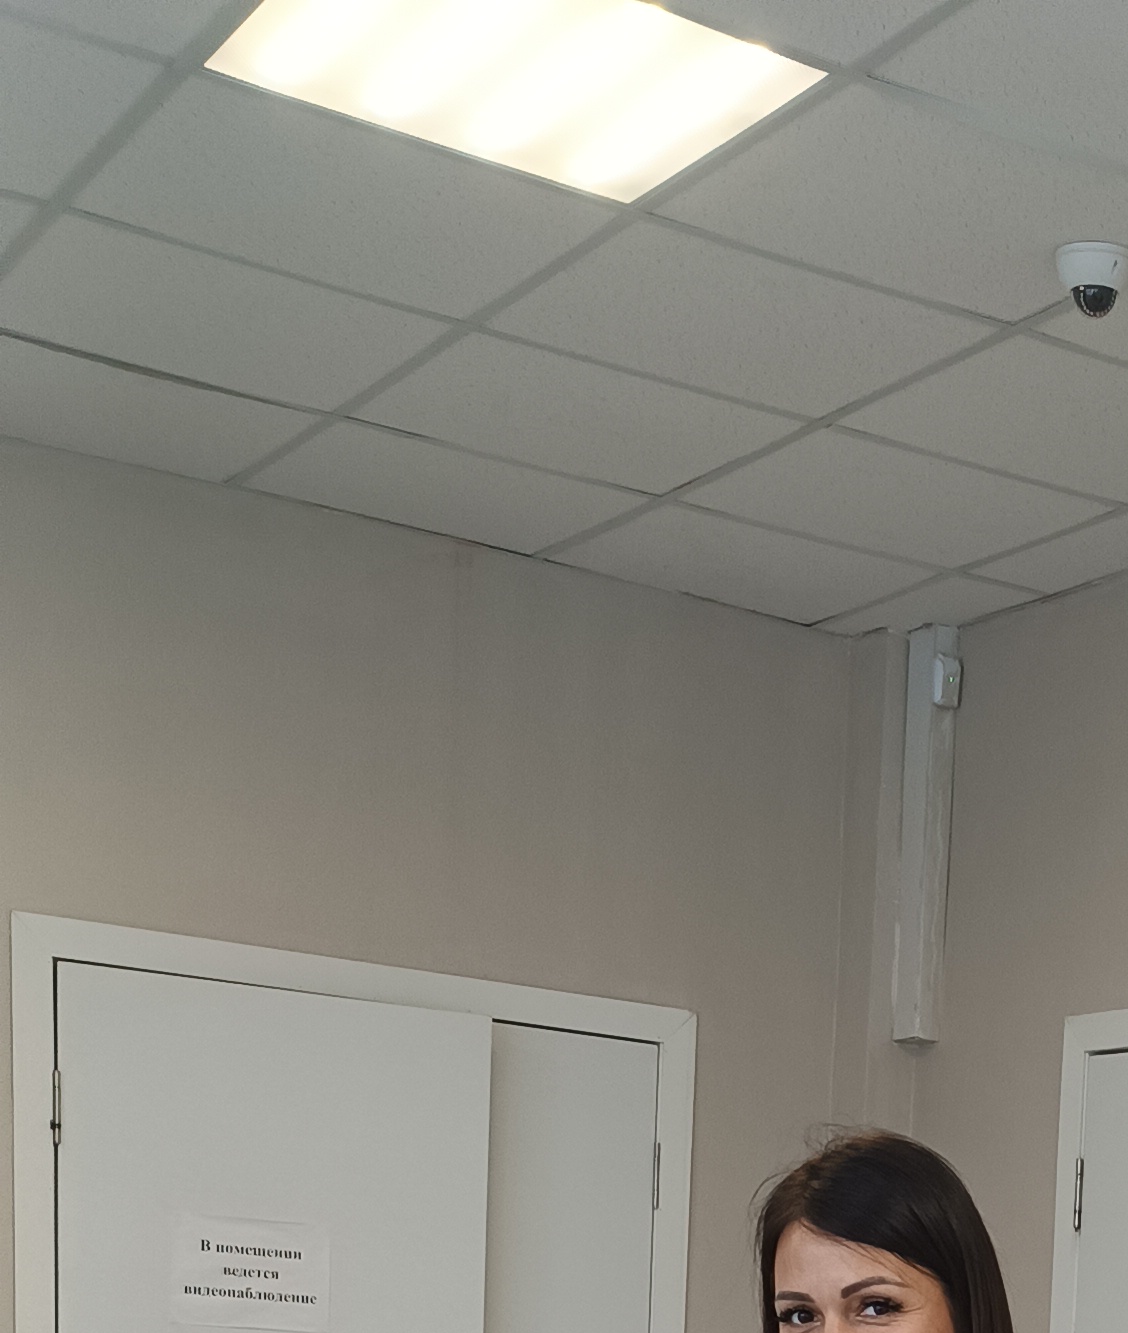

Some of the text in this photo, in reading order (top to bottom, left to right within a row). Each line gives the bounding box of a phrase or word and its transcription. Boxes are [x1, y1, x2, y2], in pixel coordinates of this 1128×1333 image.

[201, 1239, 302, 1260] В помещении
[223, 1266, 279, 1280] ведется
[184, 1285, 317, 1305] видеонаблюдение
